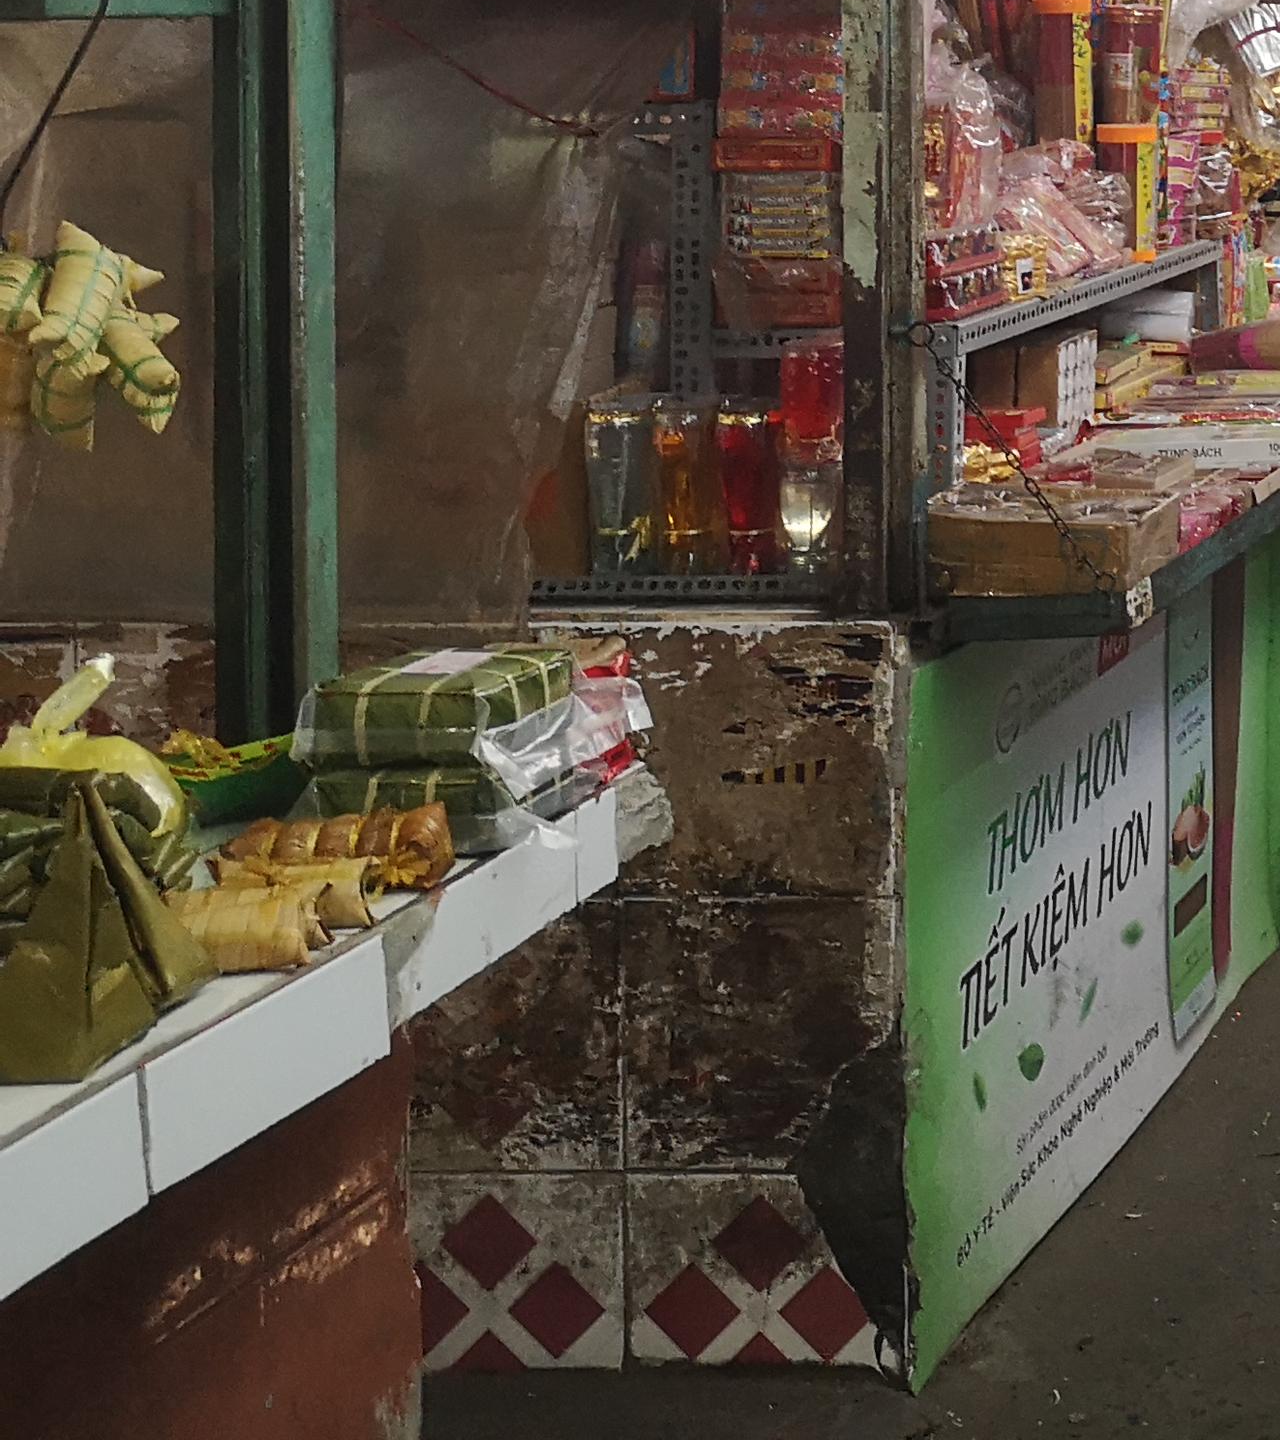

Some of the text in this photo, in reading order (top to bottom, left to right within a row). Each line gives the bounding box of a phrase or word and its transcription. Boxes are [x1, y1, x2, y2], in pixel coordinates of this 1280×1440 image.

[987, 710, 1133, 895] THƠM HƠN
[960, 800, 1152, 1050] TIẾT KIỆM HƠN
